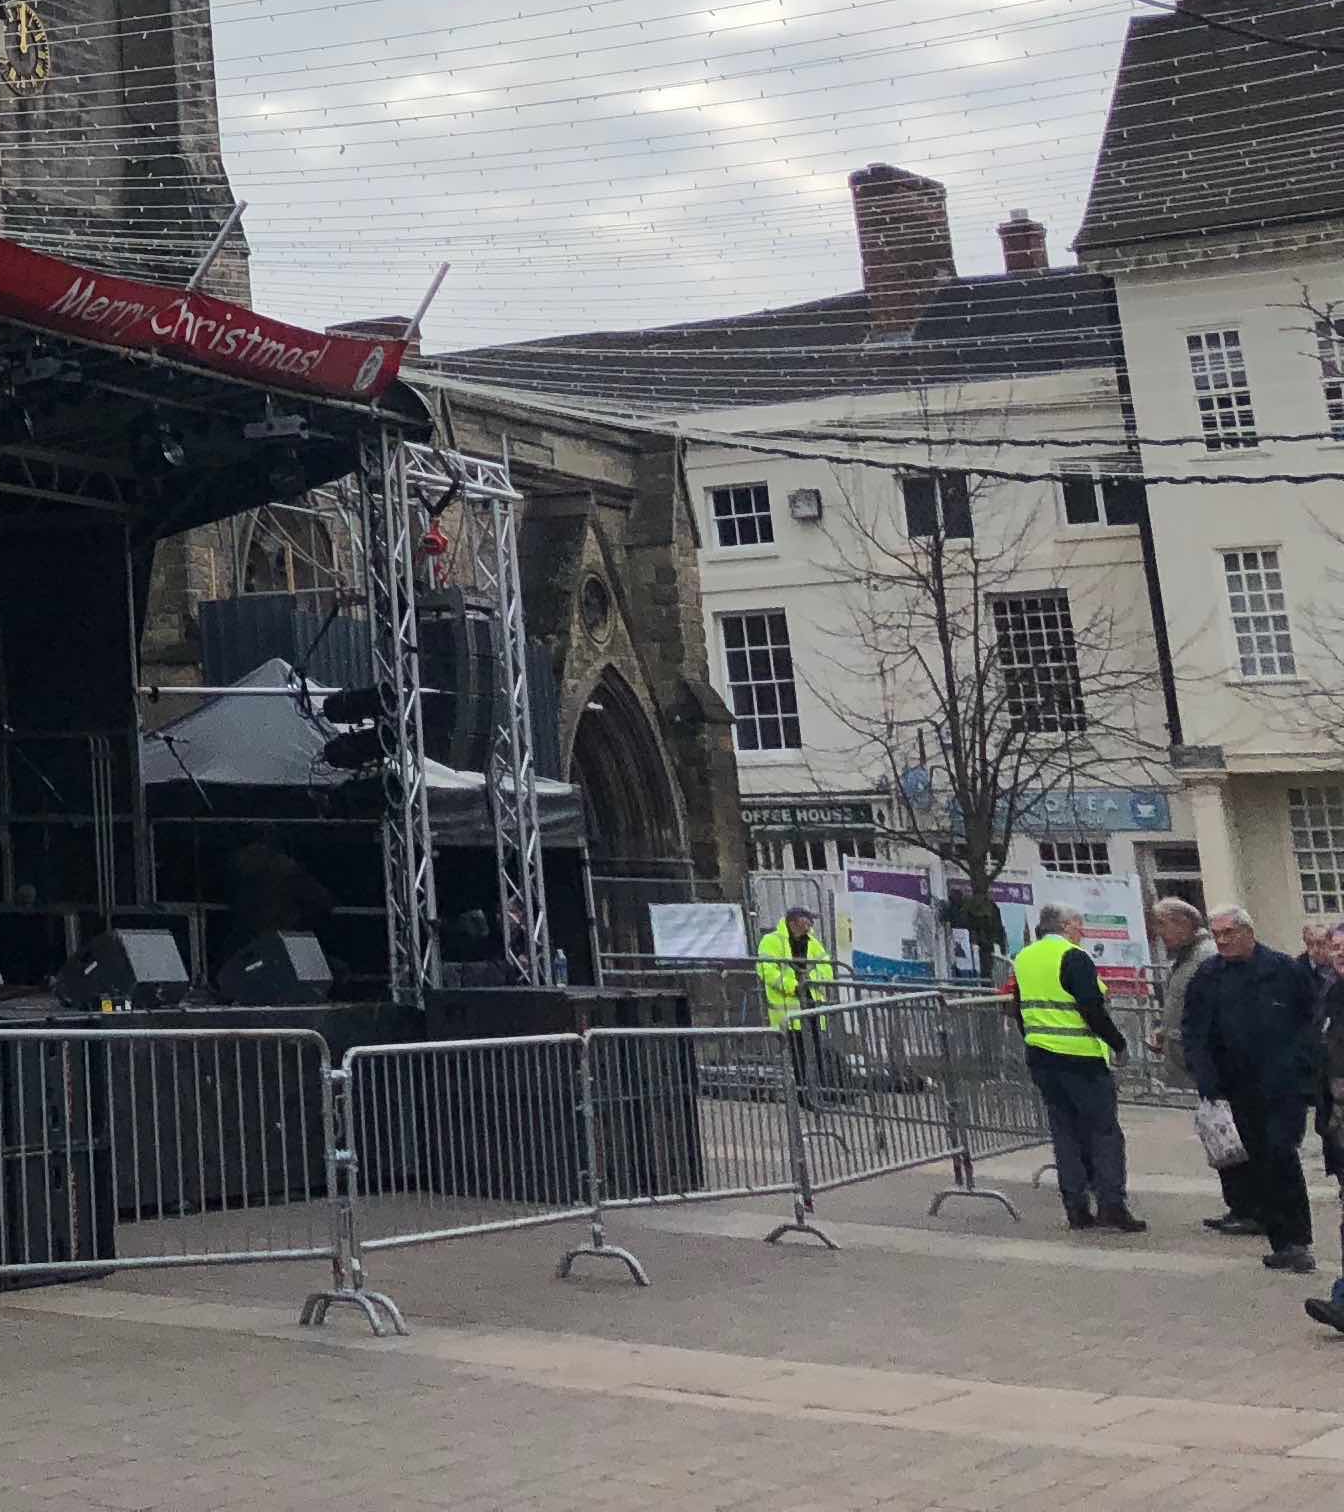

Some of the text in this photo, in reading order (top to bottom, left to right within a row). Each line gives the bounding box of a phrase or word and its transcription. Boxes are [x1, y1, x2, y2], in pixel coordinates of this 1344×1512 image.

[49, 276, 331, 376] Merry Christmas!
[741, 808, 792, 823] OFFEE
